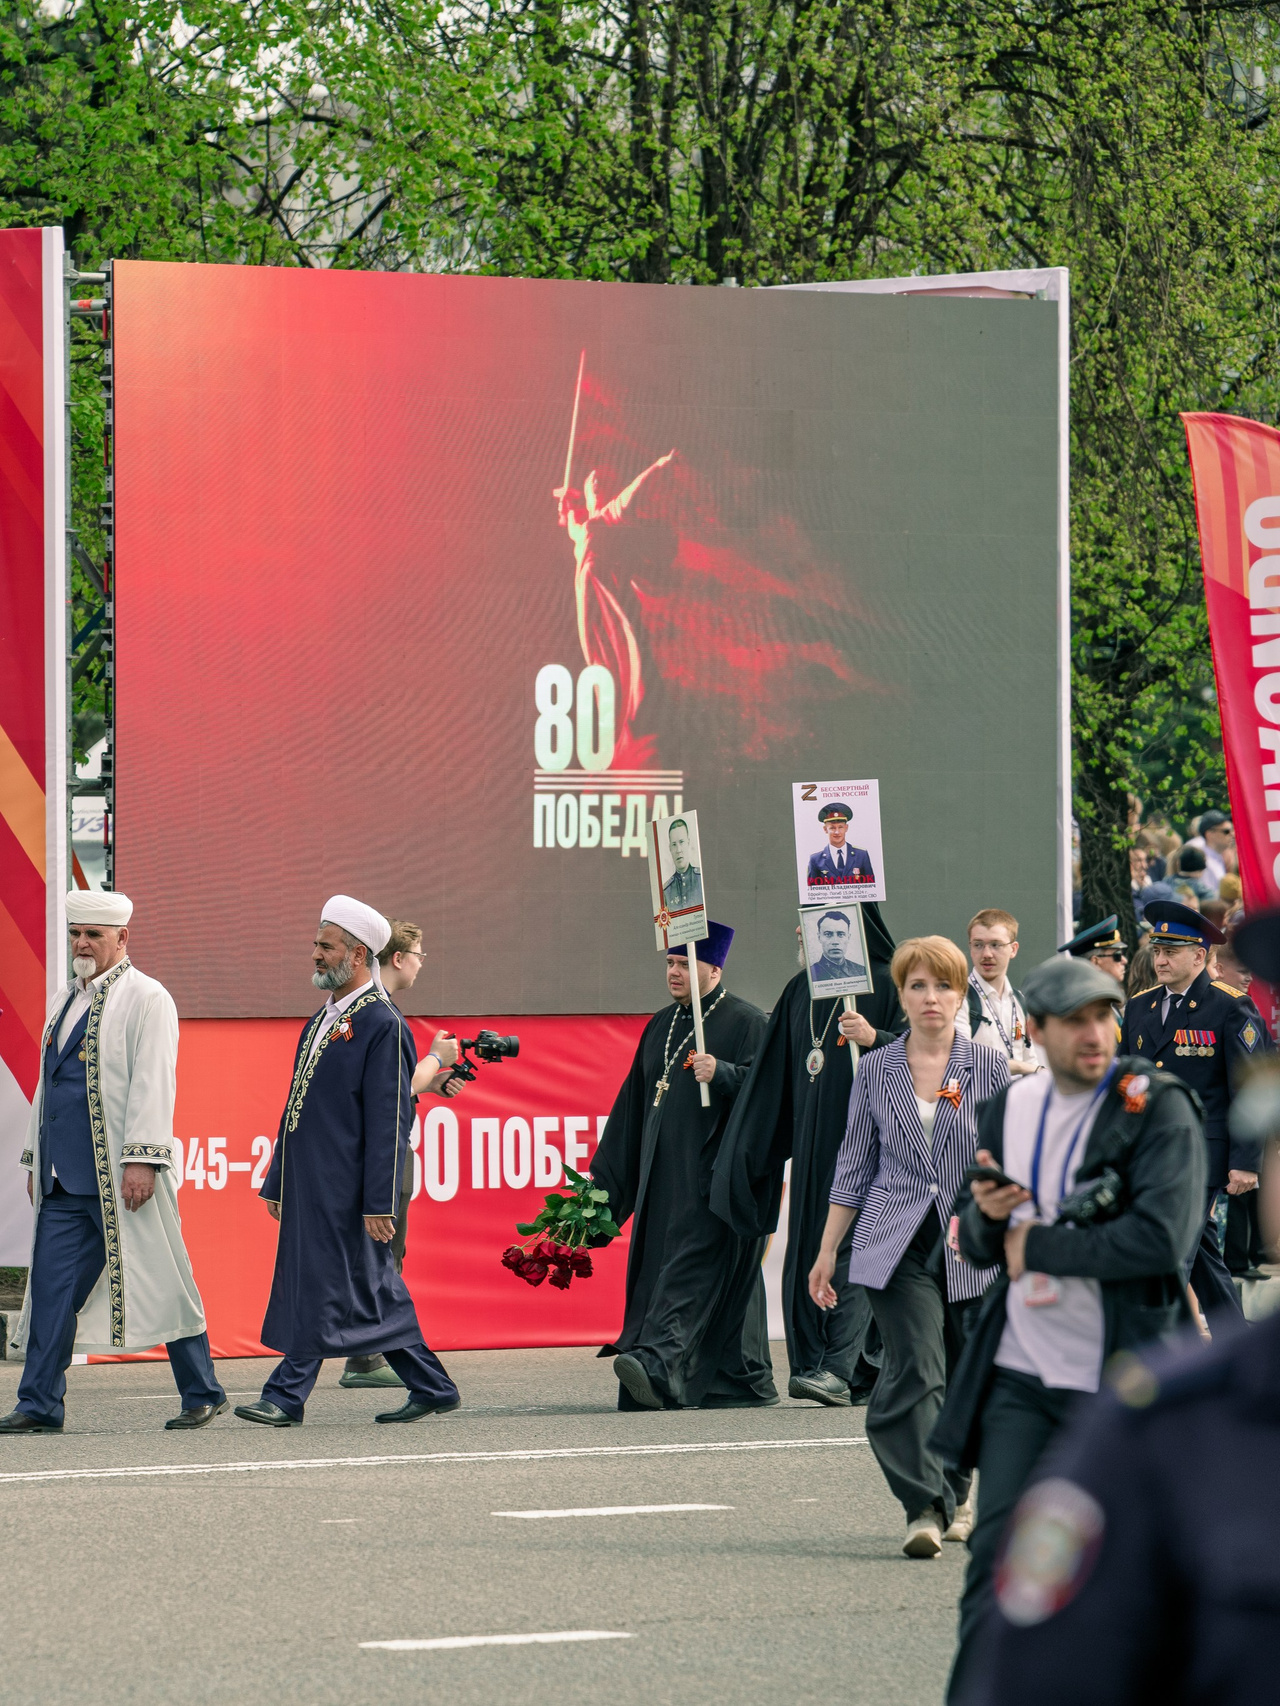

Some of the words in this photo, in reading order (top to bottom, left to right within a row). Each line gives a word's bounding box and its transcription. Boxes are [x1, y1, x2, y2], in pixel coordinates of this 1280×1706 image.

[534, 664, 615, 773] 80
[820, 784, 870, 792] БЕССМЕРТНЫЙ
[807, 874, 876, 886] РОМАНЮК
[471, 1115, 608, 1190] ПОБЕ
